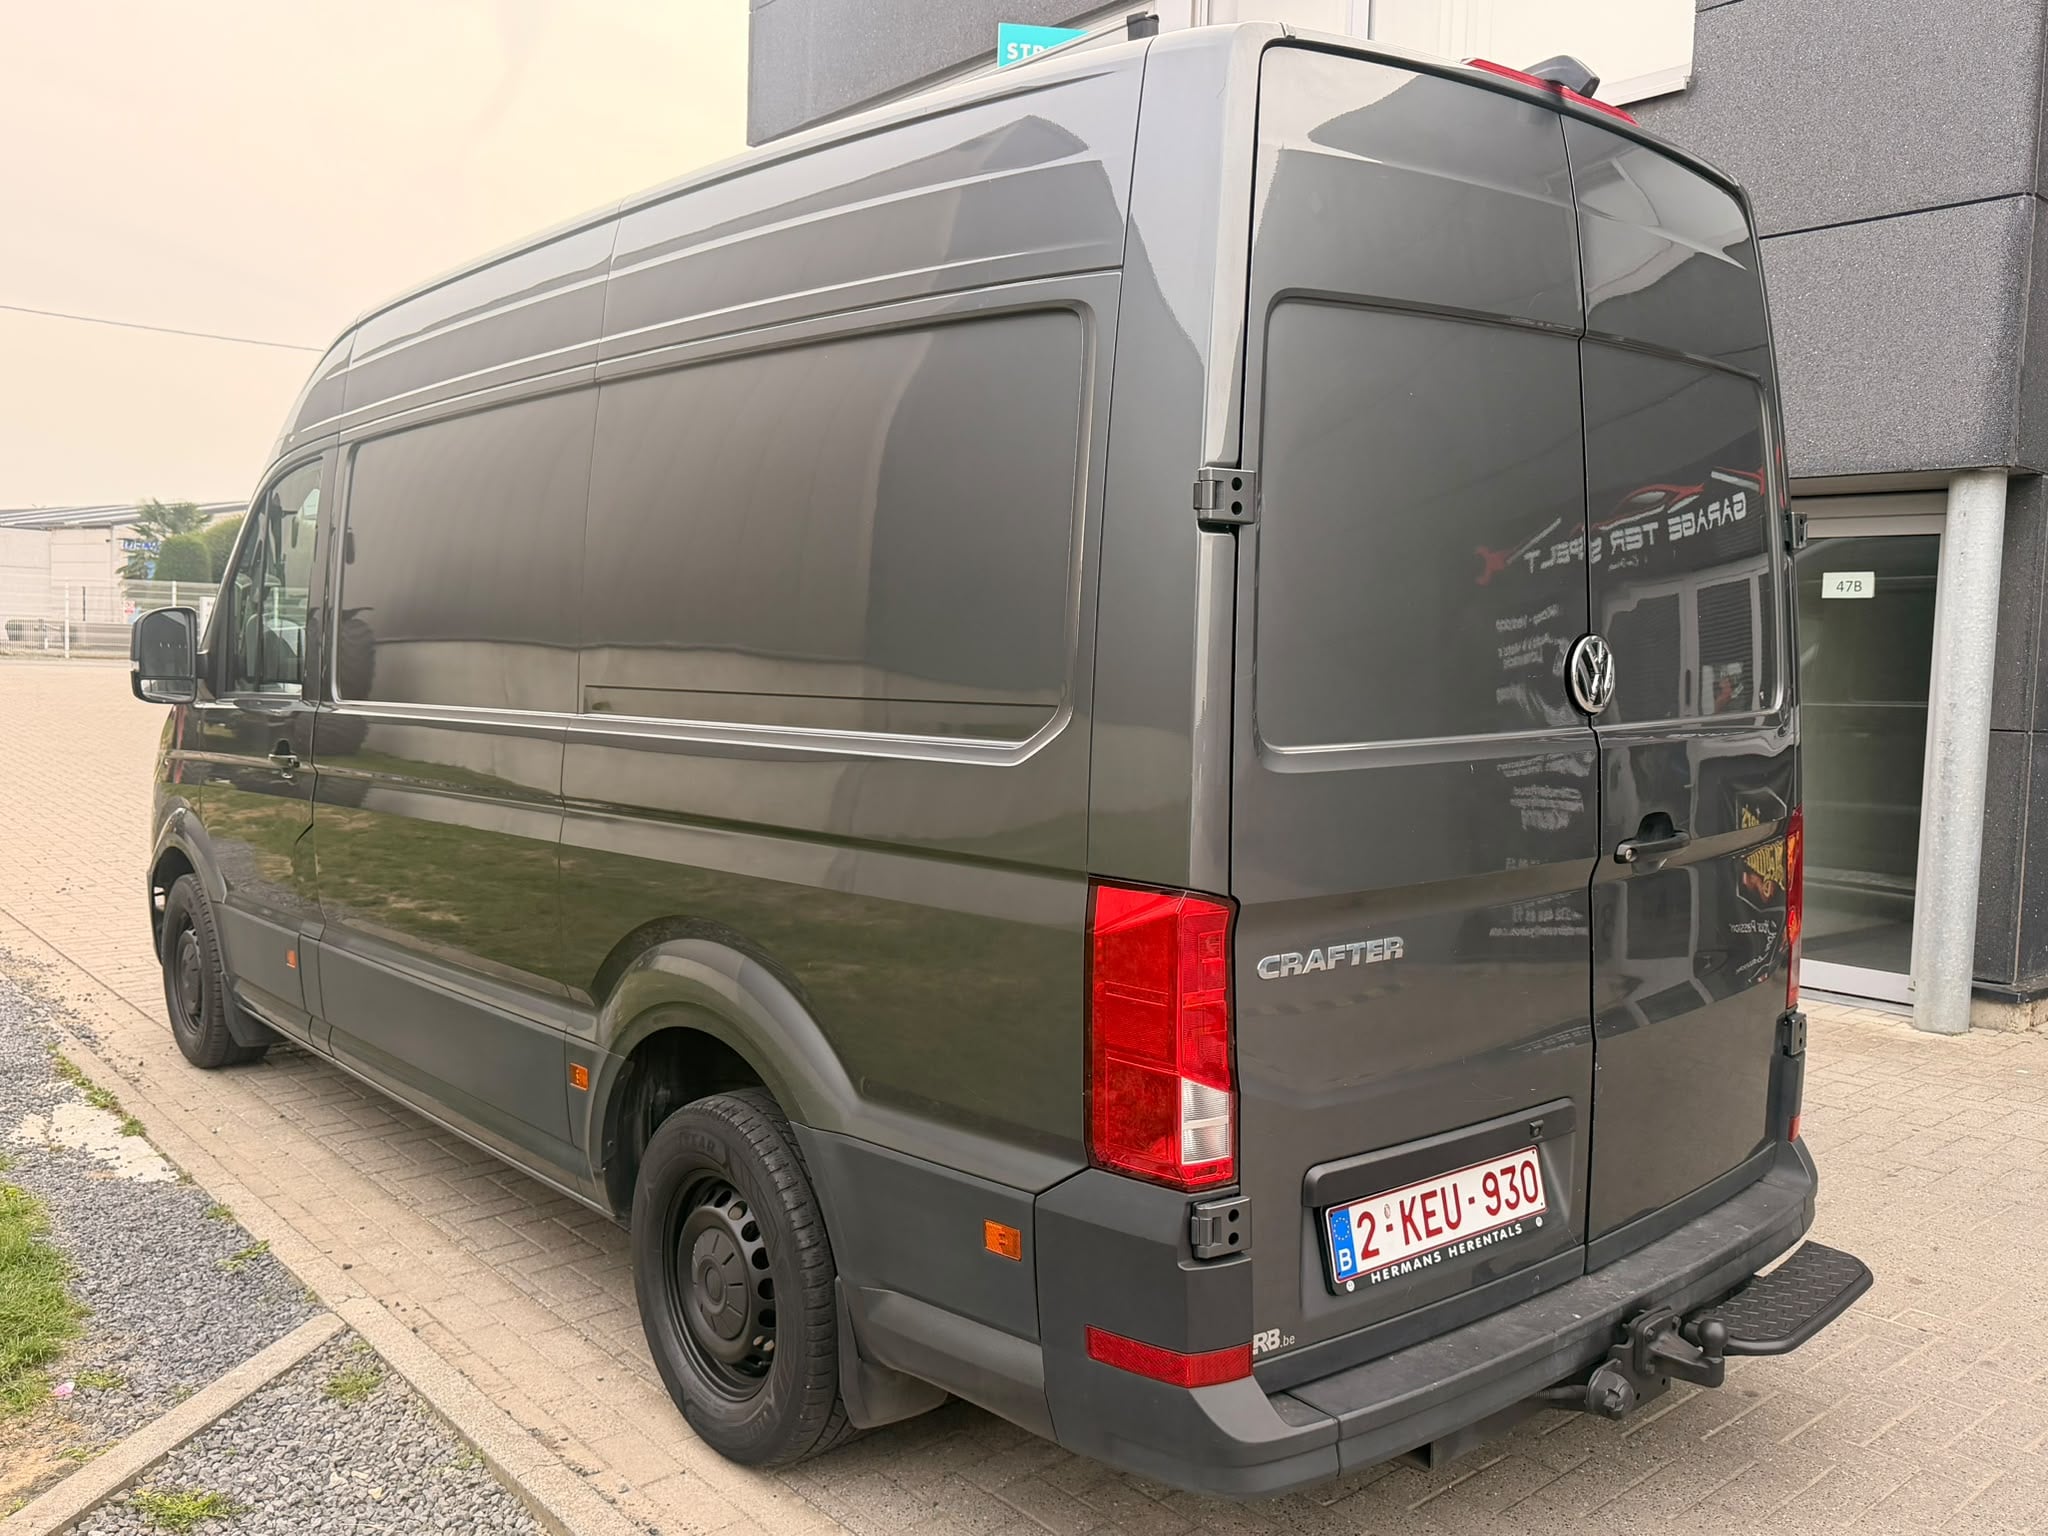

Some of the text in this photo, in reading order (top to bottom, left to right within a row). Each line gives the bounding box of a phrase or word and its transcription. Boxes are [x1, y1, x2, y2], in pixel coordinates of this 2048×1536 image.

[1836, 580, 1863, 593] 47B
[1257, 936, 1404, 980] CRAFTER
[1339, 1248, 1353, 1271] B
[1371, 1223, 1523, 1284] HERMANS HERENTALS
